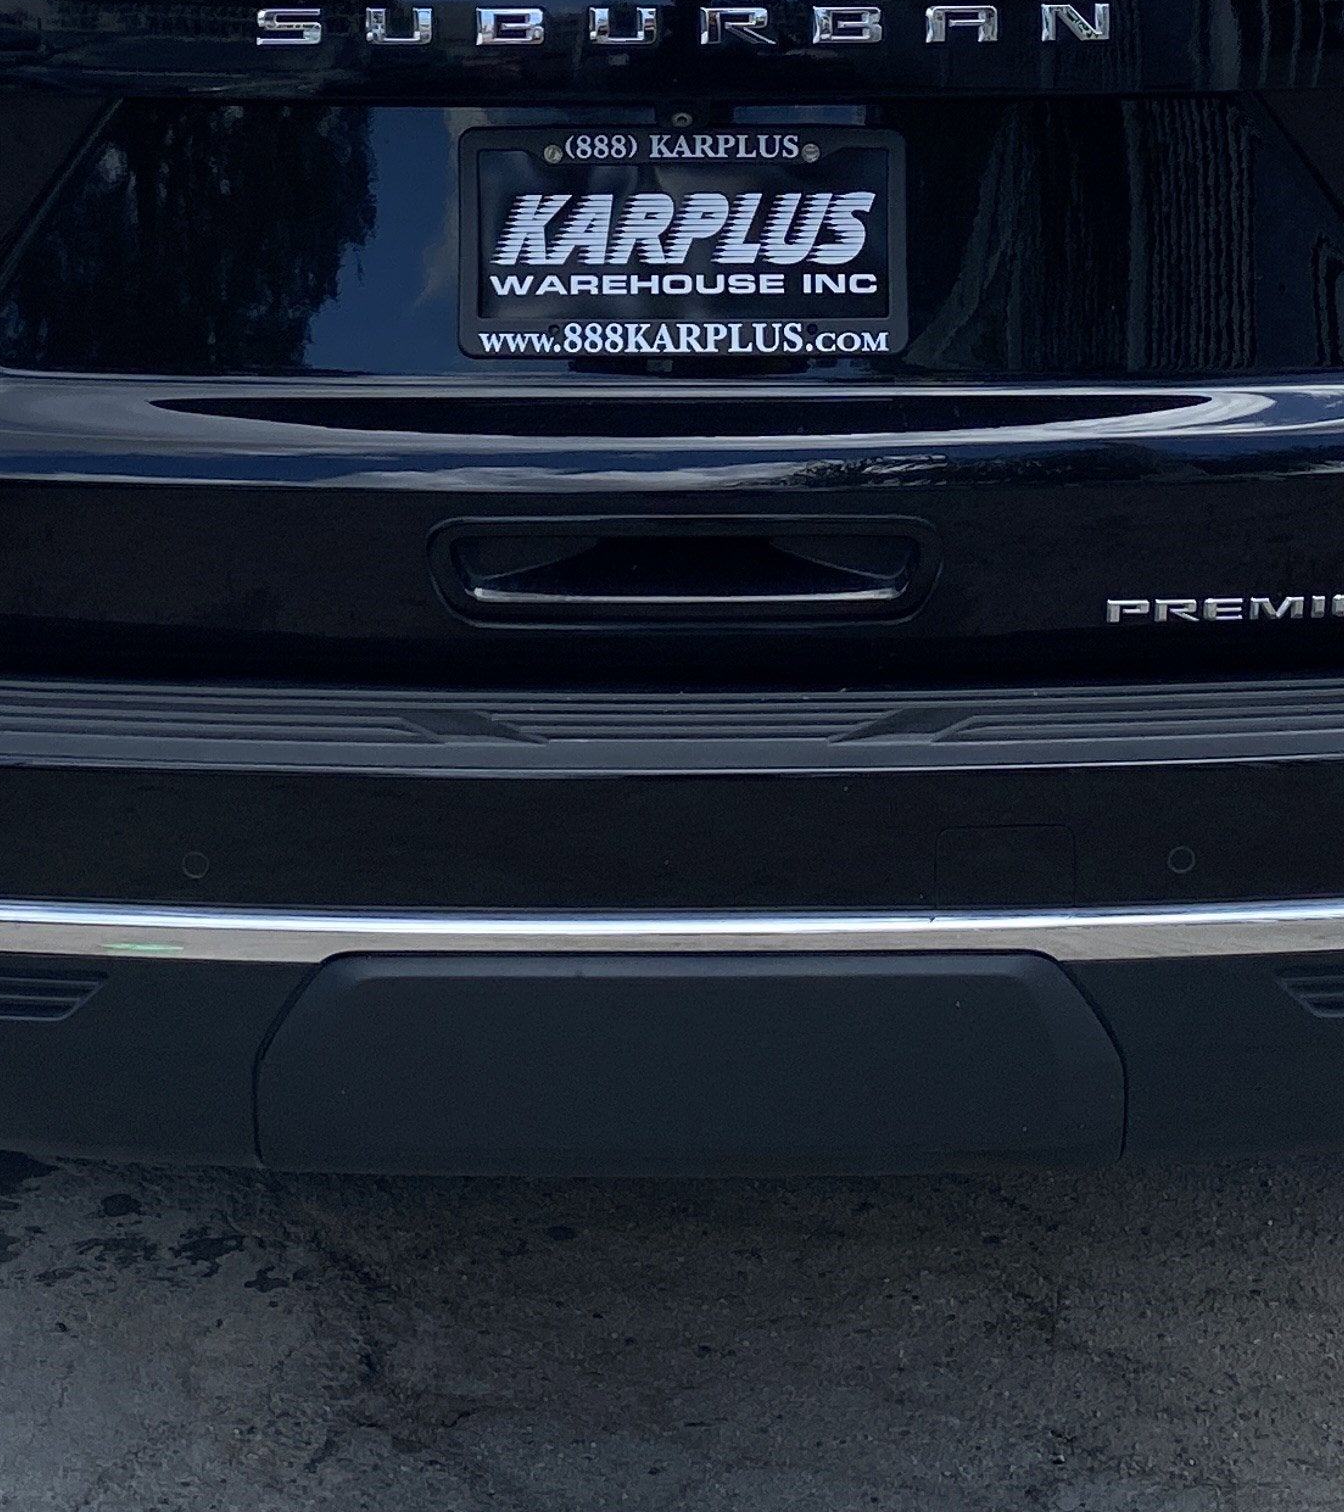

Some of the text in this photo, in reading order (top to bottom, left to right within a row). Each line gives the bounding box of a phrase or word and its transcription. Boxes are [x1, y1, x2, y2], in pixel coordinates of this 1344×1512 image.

[255, 2, 1110, 47] SUBURBAN
[565, 134, 799, 160] (888) KARPLUS
[489, 191, 876, 265] KARPLUS
[490, 273, 878, 296] WAREHOUSE INC
